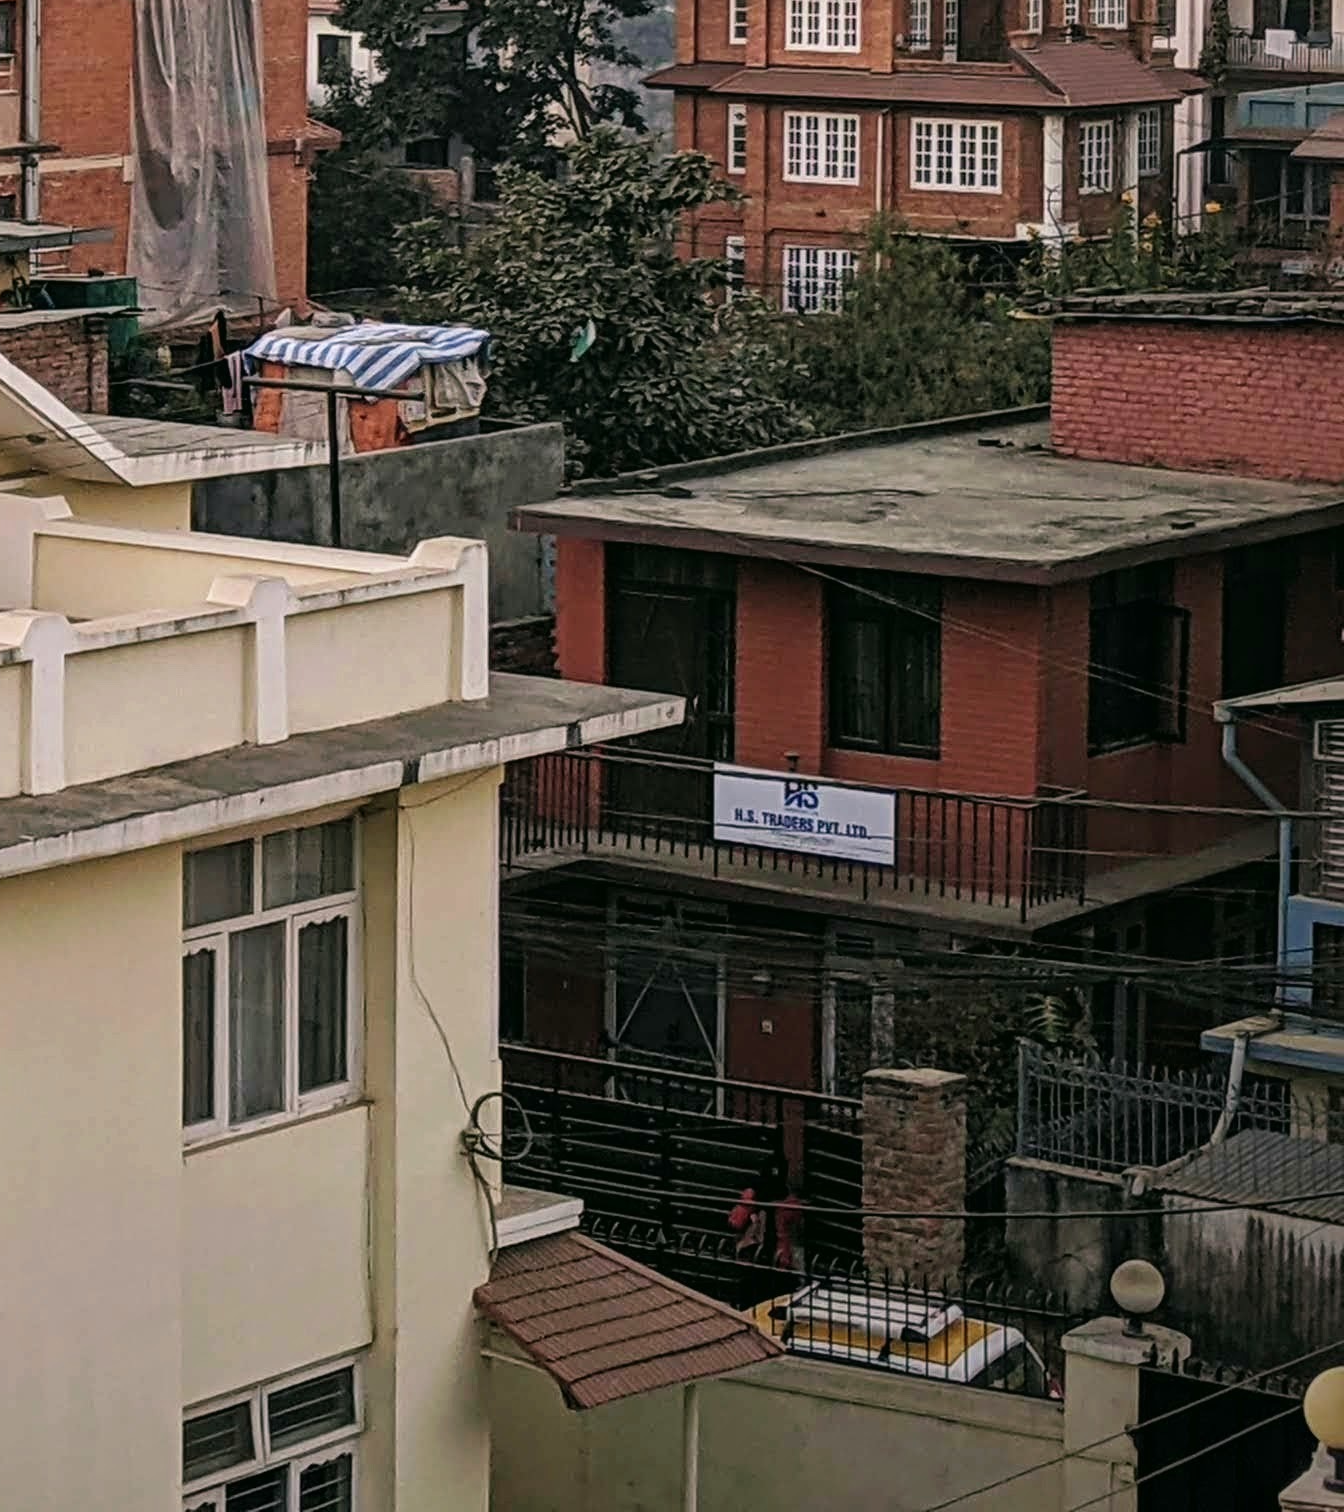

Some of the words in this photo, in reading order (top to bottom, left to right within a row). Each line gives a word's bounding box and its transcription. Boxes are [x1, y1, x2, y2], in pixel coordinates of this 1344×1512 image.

[735, 808, 759, 824] H.S.
[762, 812, 813, 832] TRADERS
[817, 819, 842, 835] PVT.
[845, 824, 872, 840] LTD.
